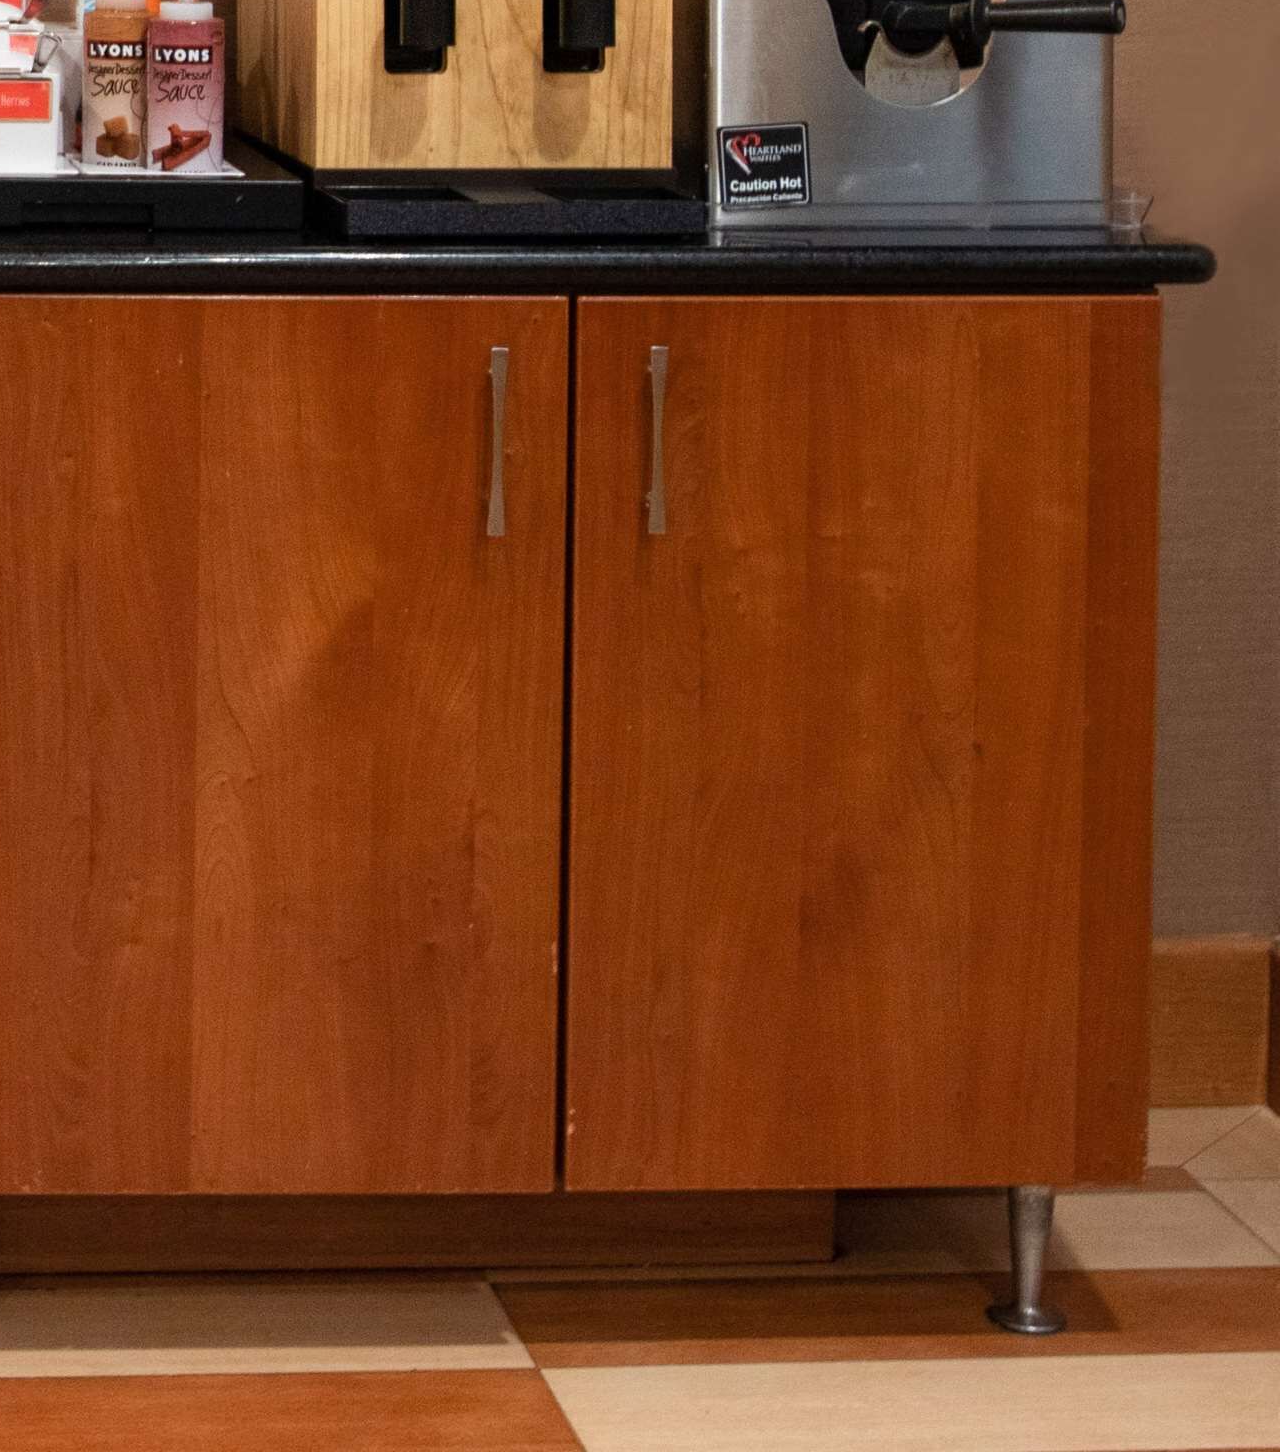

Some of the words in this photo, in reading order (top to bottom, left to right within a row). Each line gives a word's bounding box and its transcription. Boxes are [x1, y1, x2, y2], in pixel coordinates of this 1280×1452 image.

[89, 43, 143, 57] LYONS
[155, 49, 210, 62] LYONS
[91, 74, 141, 97] Sauce
[156, 80, 206, 103] Sauce
[744, 144, 802, 156] HEARTLAND
[730, 179, 777, 192] Caution
[780, 177, 802, 189] Hot
